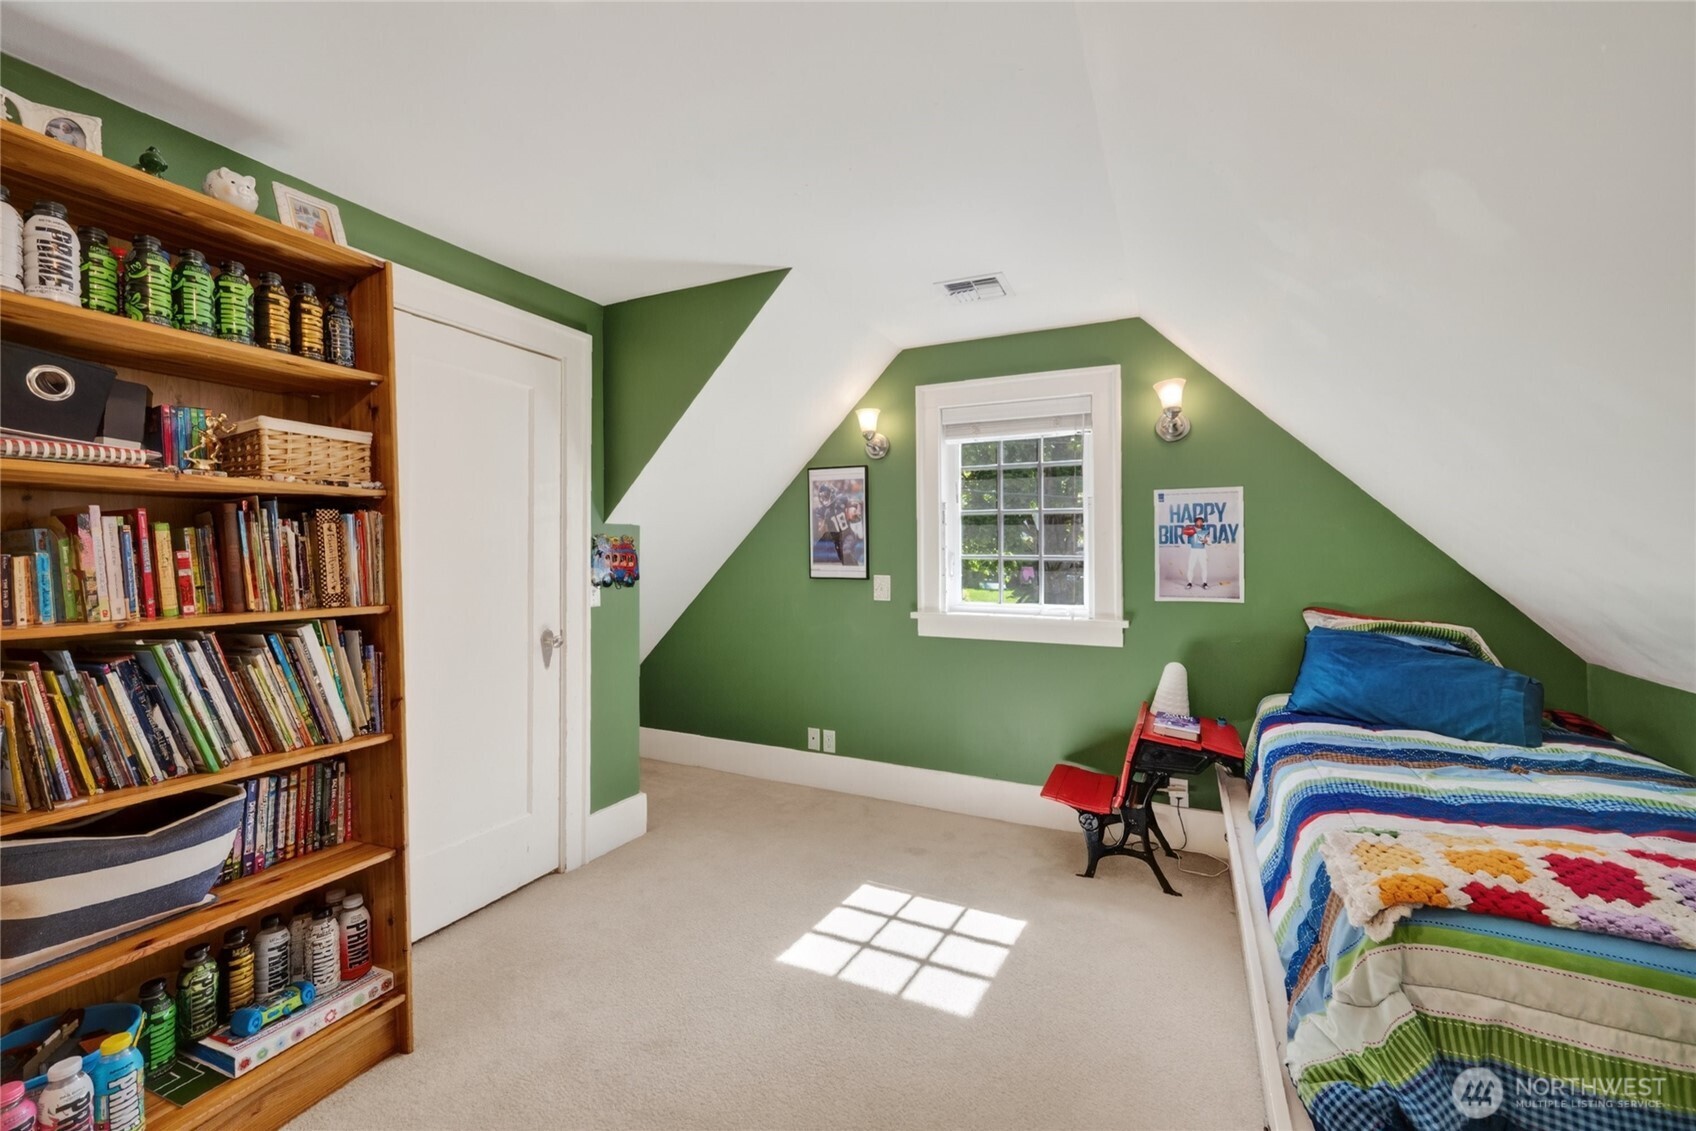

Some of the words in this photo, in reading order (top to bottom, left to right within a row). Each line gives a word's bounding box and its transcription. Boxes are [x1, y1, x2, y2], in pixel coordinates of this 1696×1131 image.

[88, 252, 118, 314] PRIME
[182, 269, 214, 328] PRIME
[219, 280, 249, 334] PRIME
[831, 512, 849, 532] 18
[1158, 523, 1239, 545] BIRDAY
[1169, 502, 1227, 523] HAPPY
[346, 919, 370, 969] PRIME
